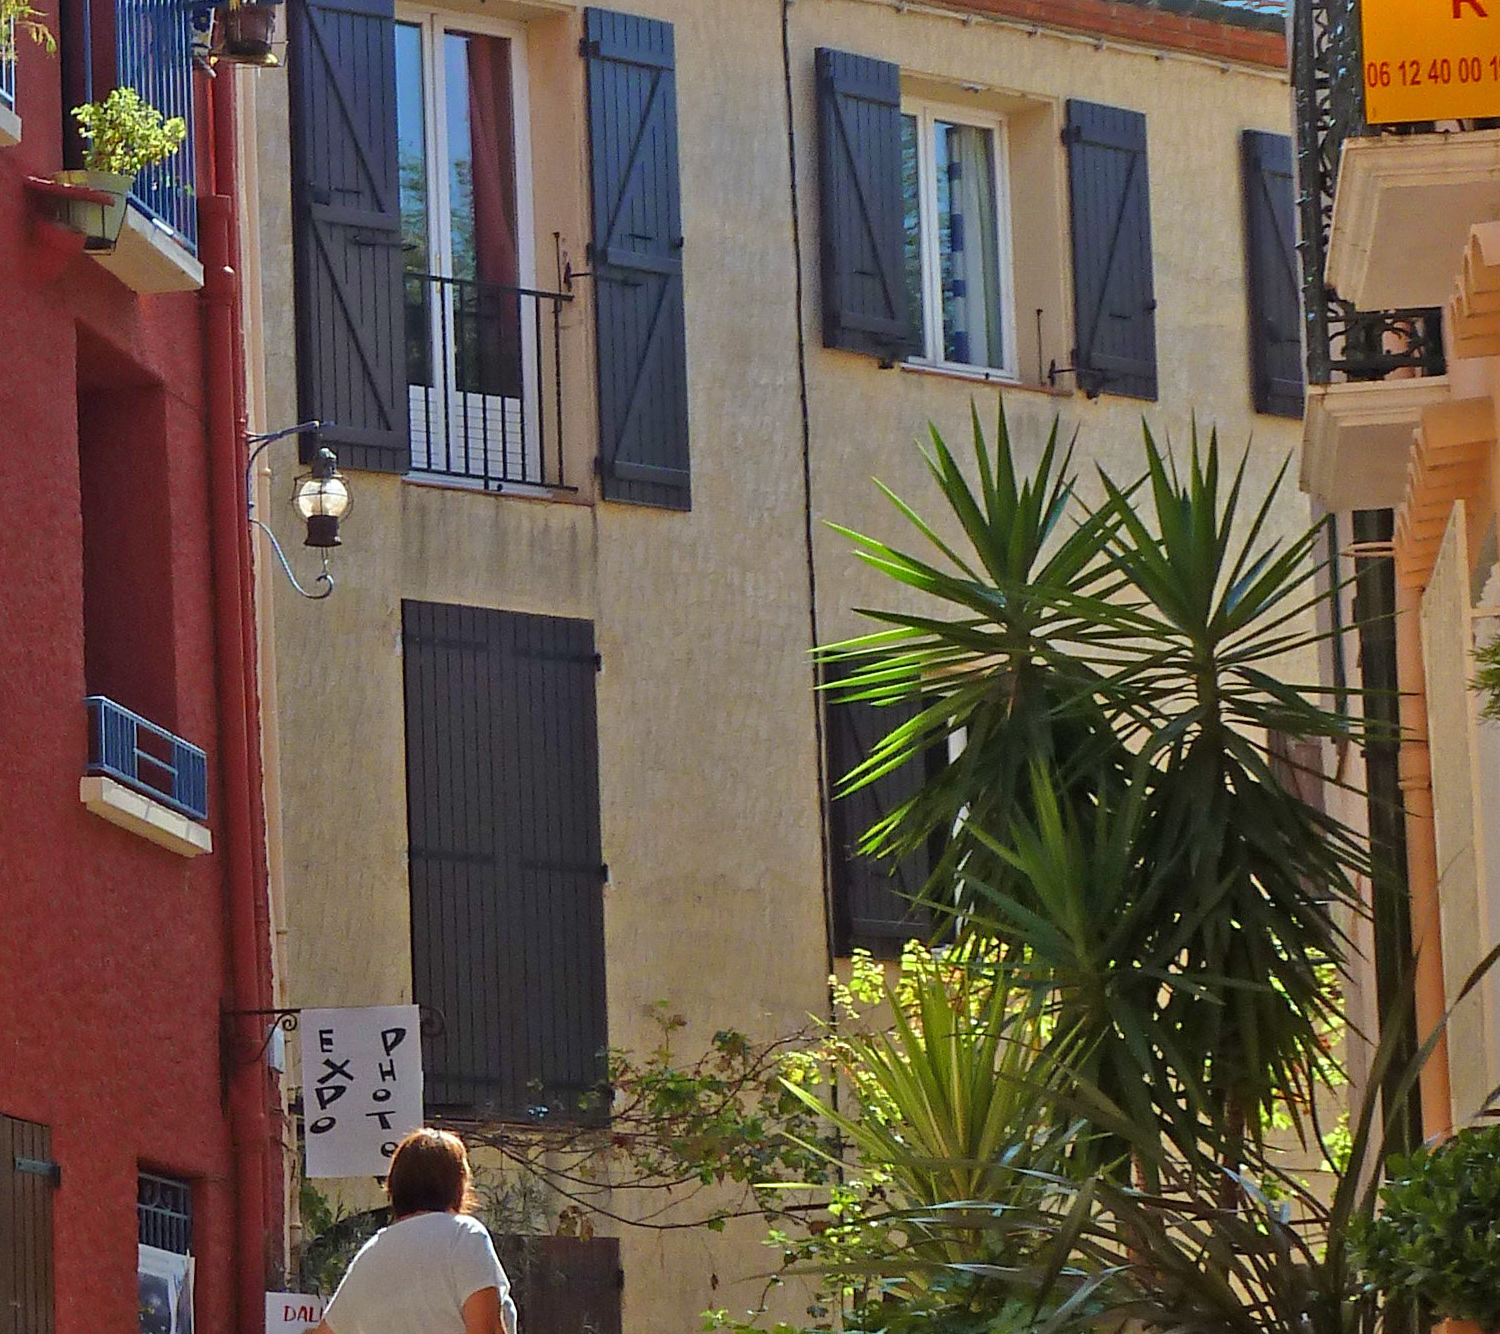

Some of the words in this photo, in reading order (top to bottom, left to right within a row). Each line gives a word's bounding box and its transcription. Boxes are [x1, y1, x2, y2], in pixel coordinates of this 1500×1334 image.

[1367, 61, 1390, 87] 06
[1399, 60, 1421, 86] 12
[1428, 58, 1451, 84] 40
[1458, 56, 1481, 83] 00
[1489, 55, 1500, 82] 1
[310, 1028, 355, 1135] EXPO
[365, 1027, 407, 1158] PHOTO
